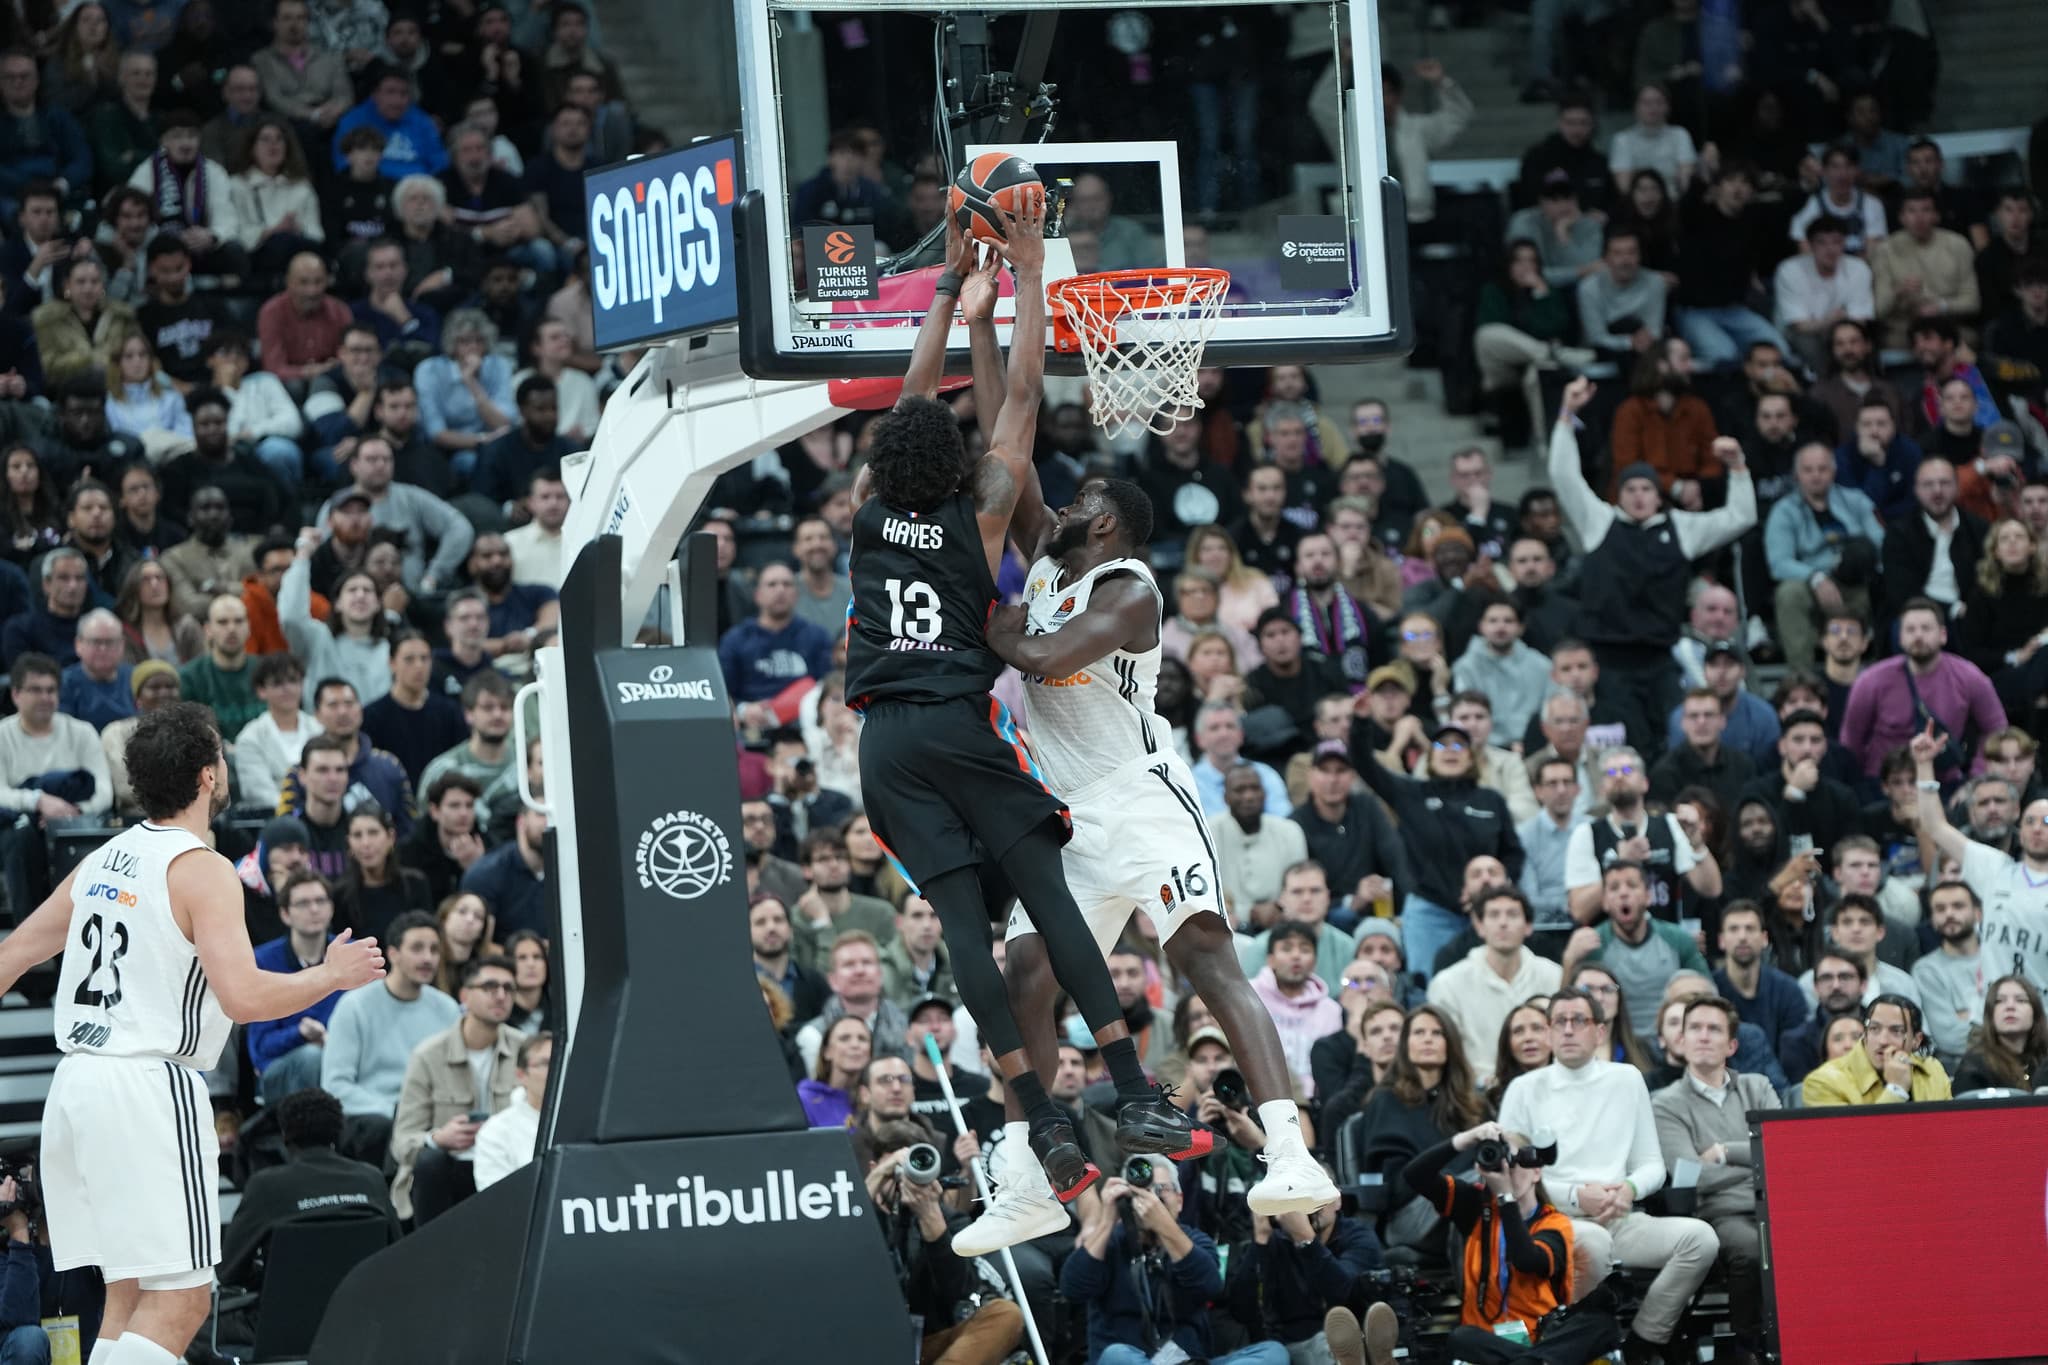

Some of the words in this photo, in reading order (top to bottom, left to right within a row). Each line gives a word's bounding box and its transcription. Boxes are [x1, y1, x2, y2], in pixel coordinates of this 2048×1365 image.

[591, 165, 721, 324] snipes
[1299, 246, 1345, 257] oneteam
[817, 266, 867, 277] TURKISH
[817, 276, 868, 288] AIRLINES
[817, 287, 869, 299] EuroLeague
[792, 333, 853, 349] SPALDING
[882, 517, 944, 550] HAYES
[885, 578, 944, 644] 13
[617, 679, 715, 704] SPALDING
[635, 830, 654, 889] PARIS
[651, 810, 734, 886] BASKETBALL
[1171, 862, 1209, 902] 16
[1985, 922, 2048, 957] PARI
[74, 912, 129, 1010] 23
